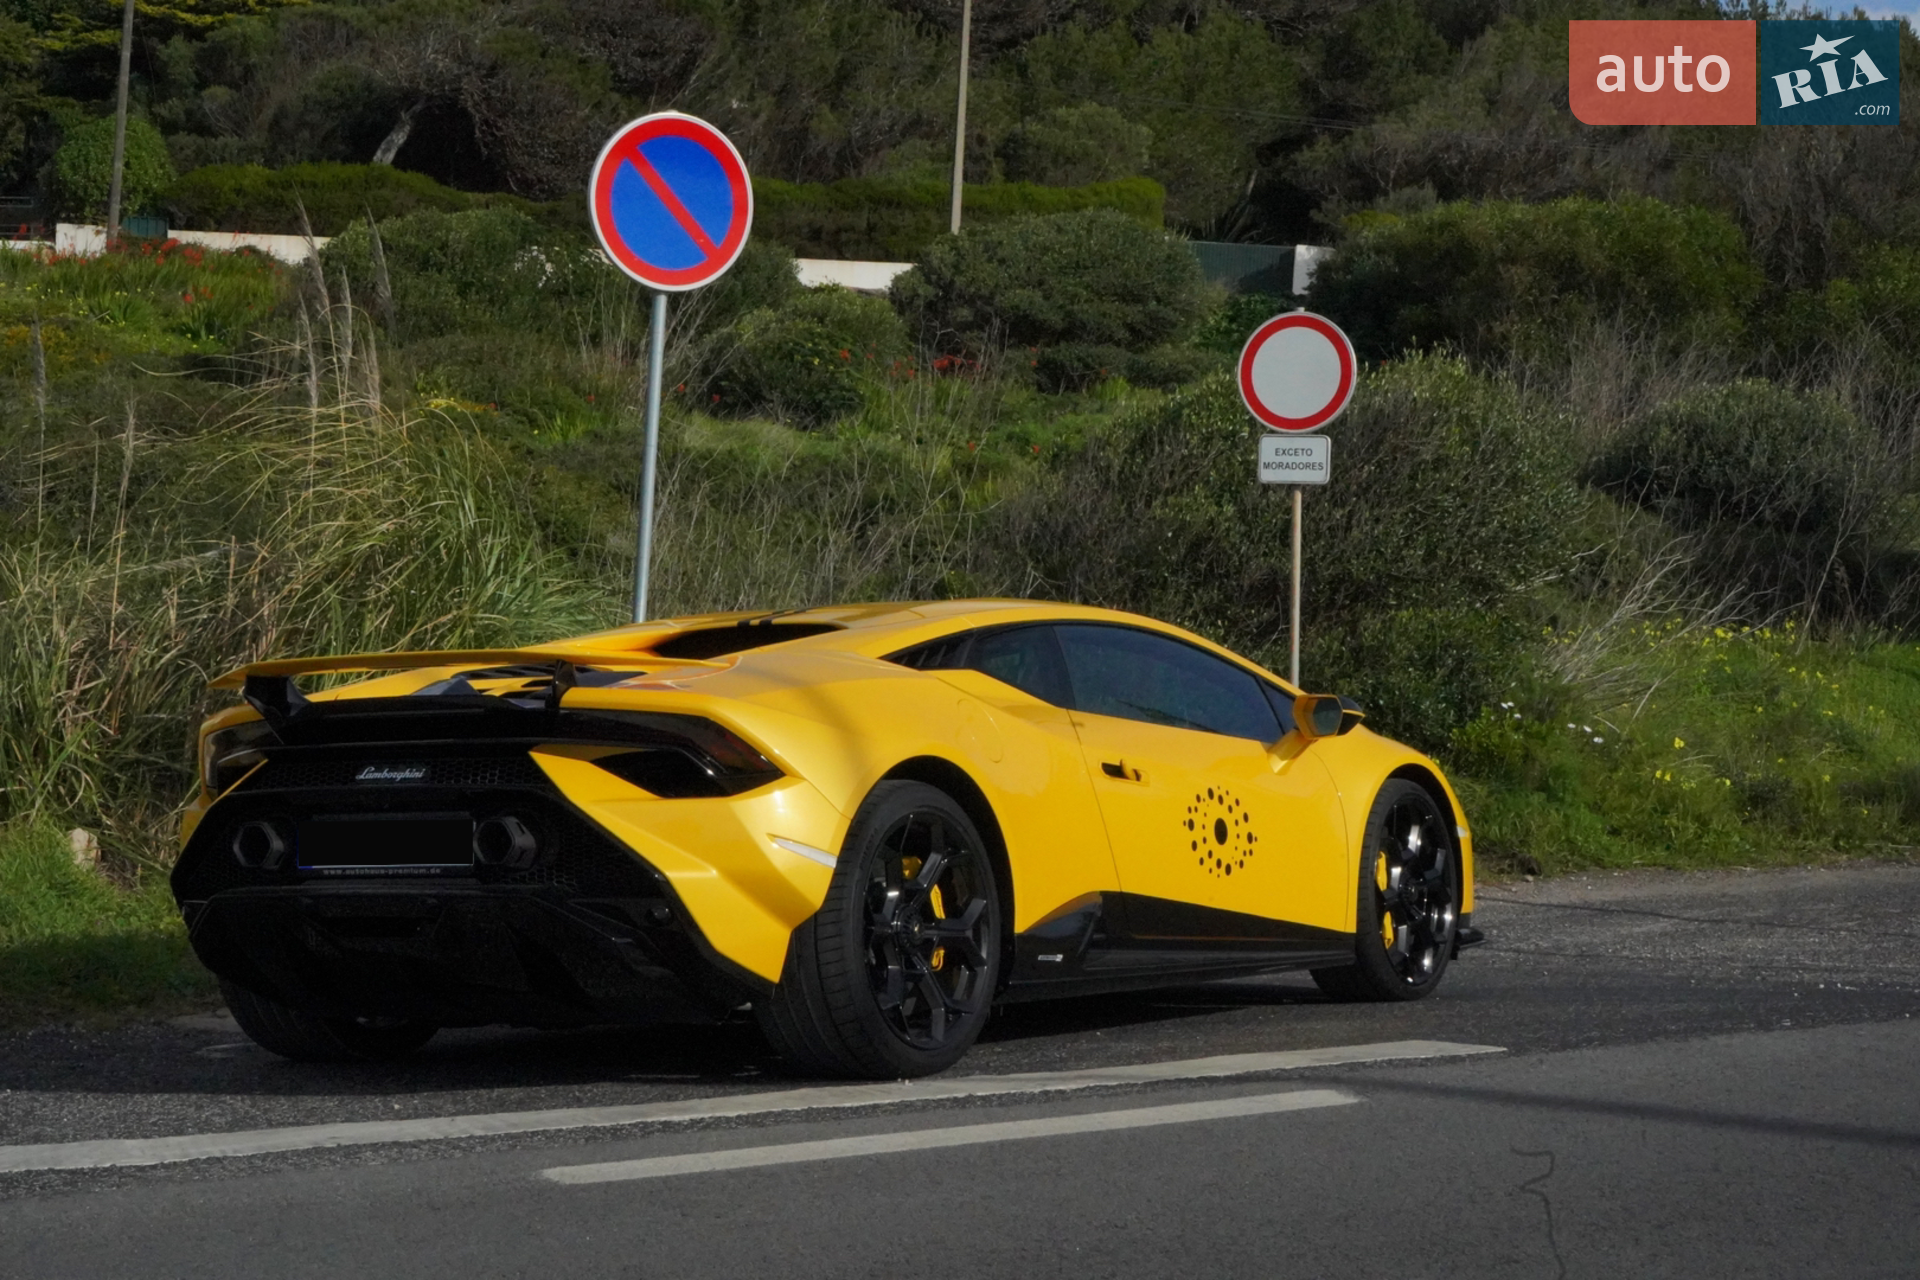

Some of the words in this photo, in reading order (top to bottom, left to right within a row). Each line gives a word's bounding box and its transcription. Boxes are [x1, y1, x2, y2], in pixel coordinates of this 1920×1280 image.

[1274, 447, 1313, 457] EXCETO
[1262, 461, 1324, 471] MORADORES
[355, 766, 426, 782] Lamborghini
